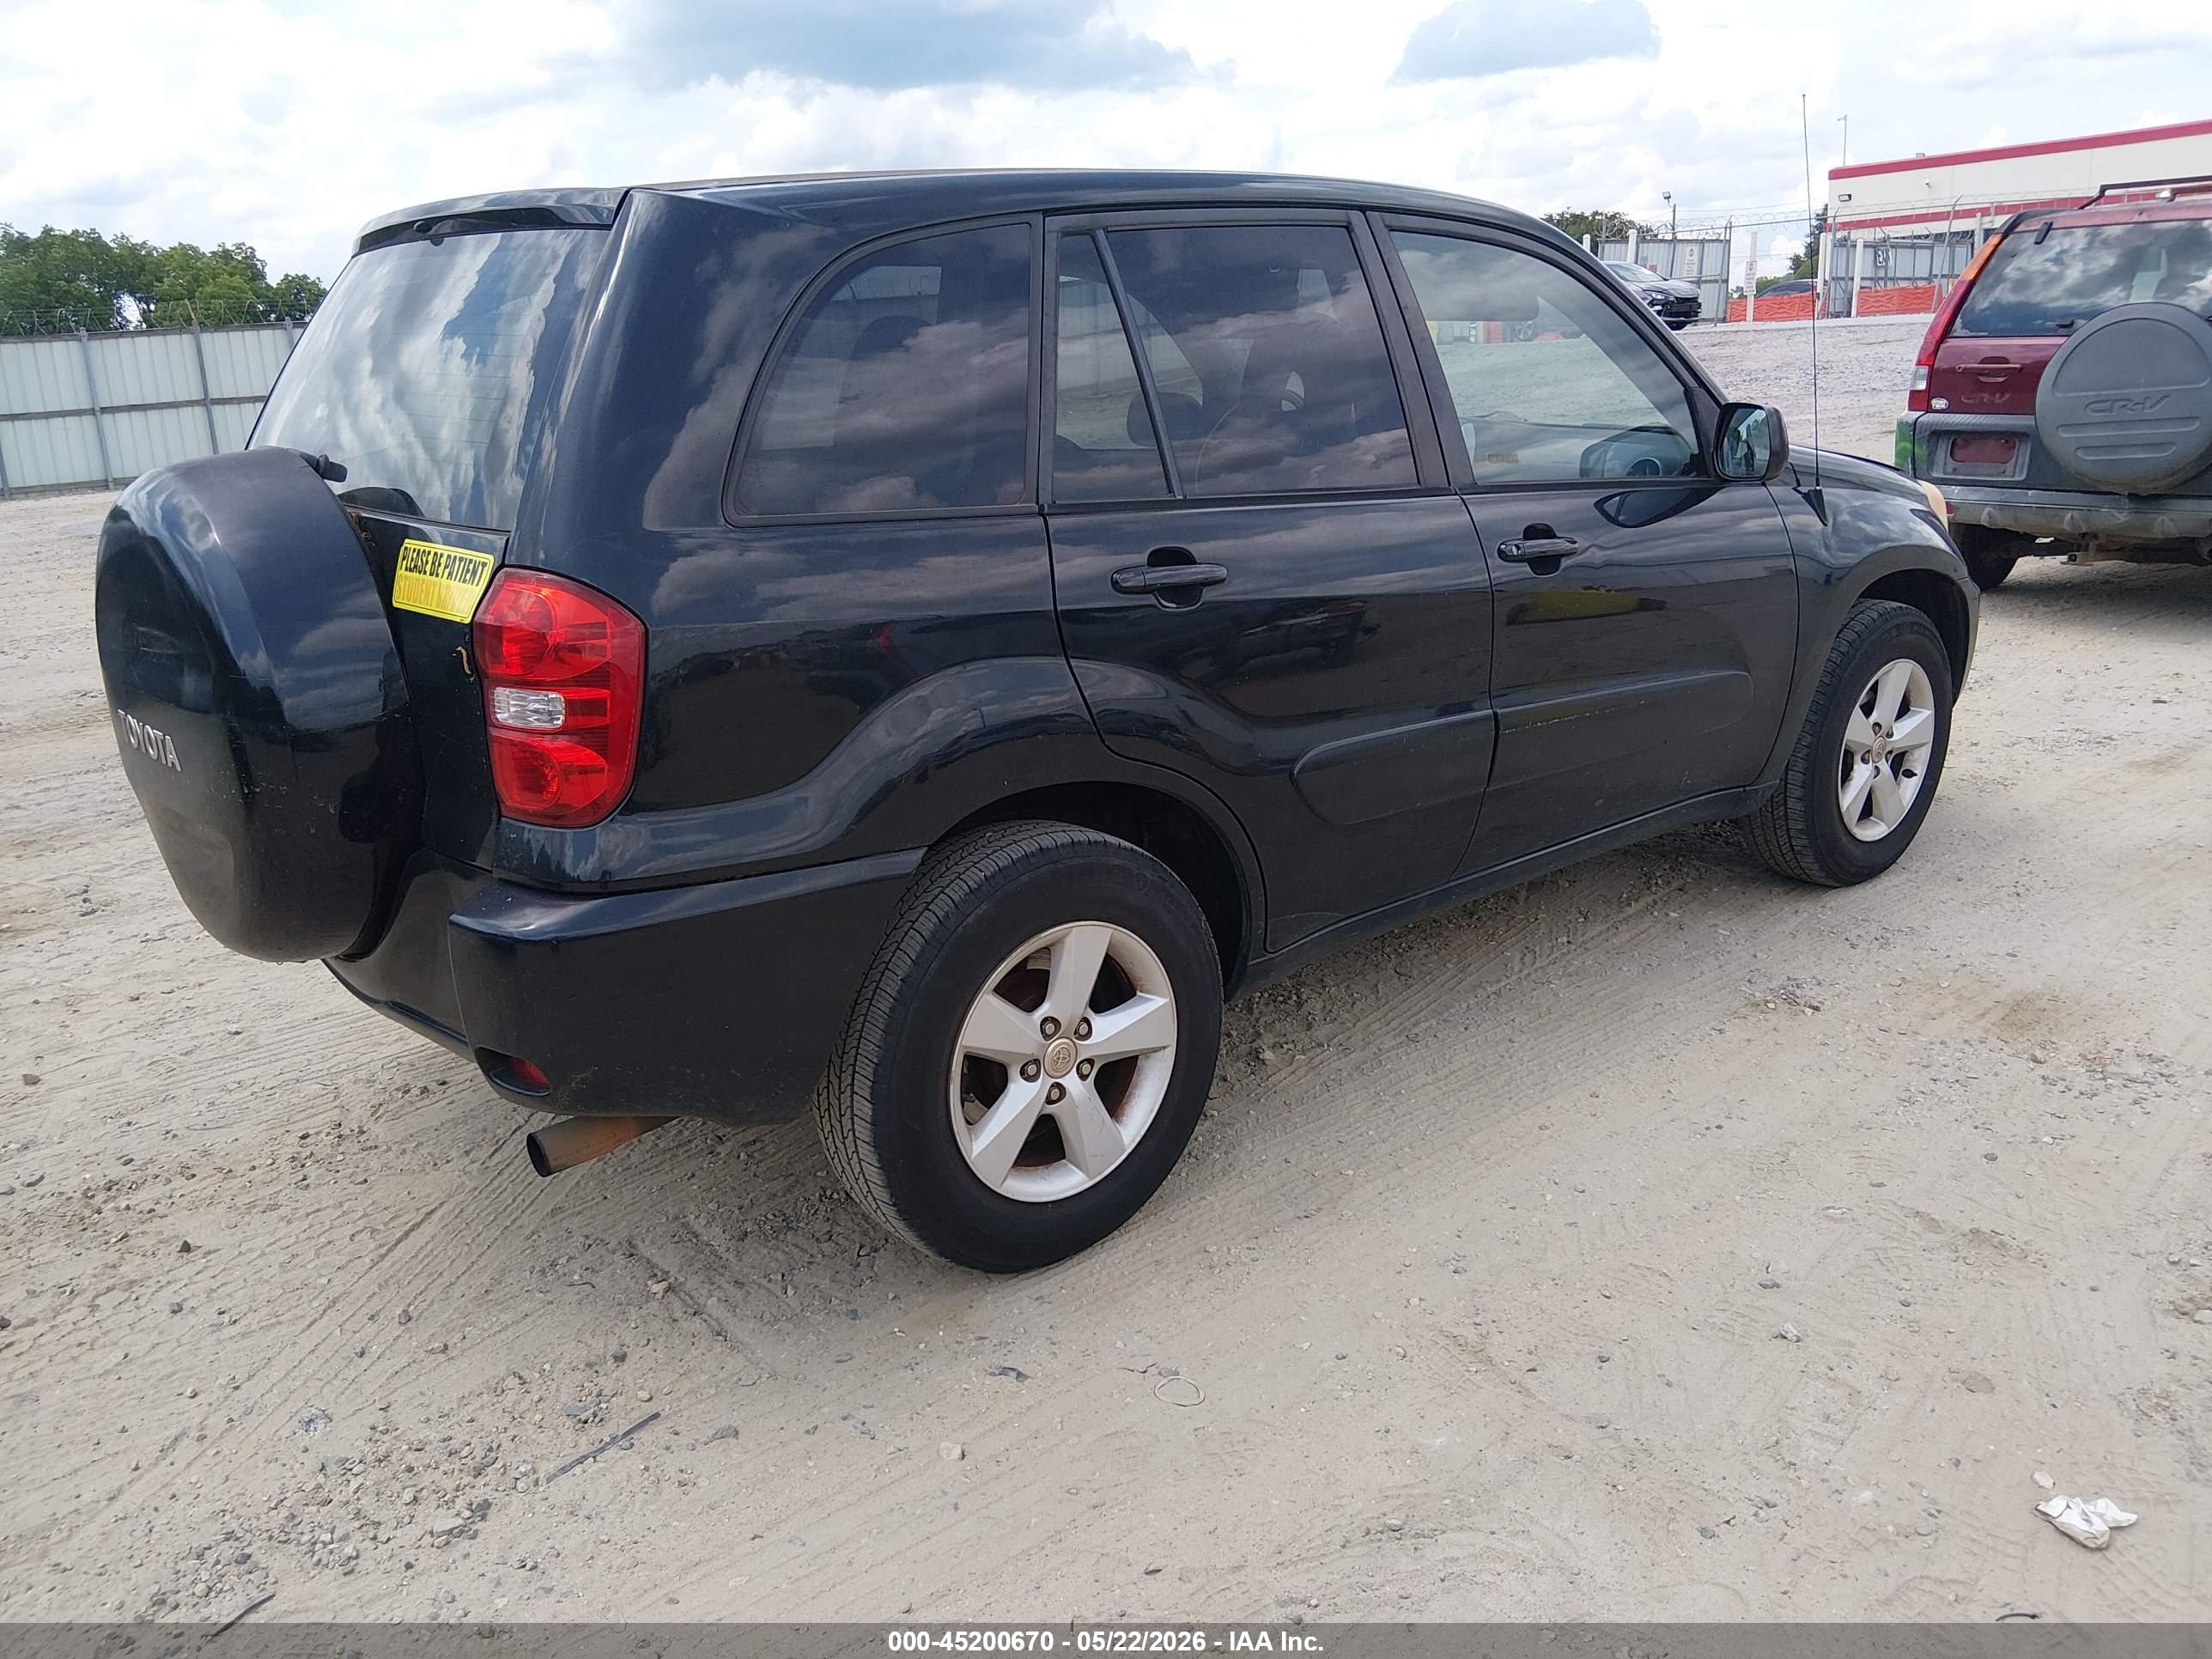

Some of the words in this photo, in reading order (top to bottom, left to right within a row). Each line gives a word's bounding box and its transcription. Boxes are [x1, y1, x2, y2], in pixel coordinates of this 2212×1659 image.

[2084, 395, 2170, 416] CR-V
[400, 545, 432, 575] PLEASE
[429, 551, 445, 578] BE
[441, 554, 489, 586] PATIENT
[117, 708, 182, 772] TOYOTA
